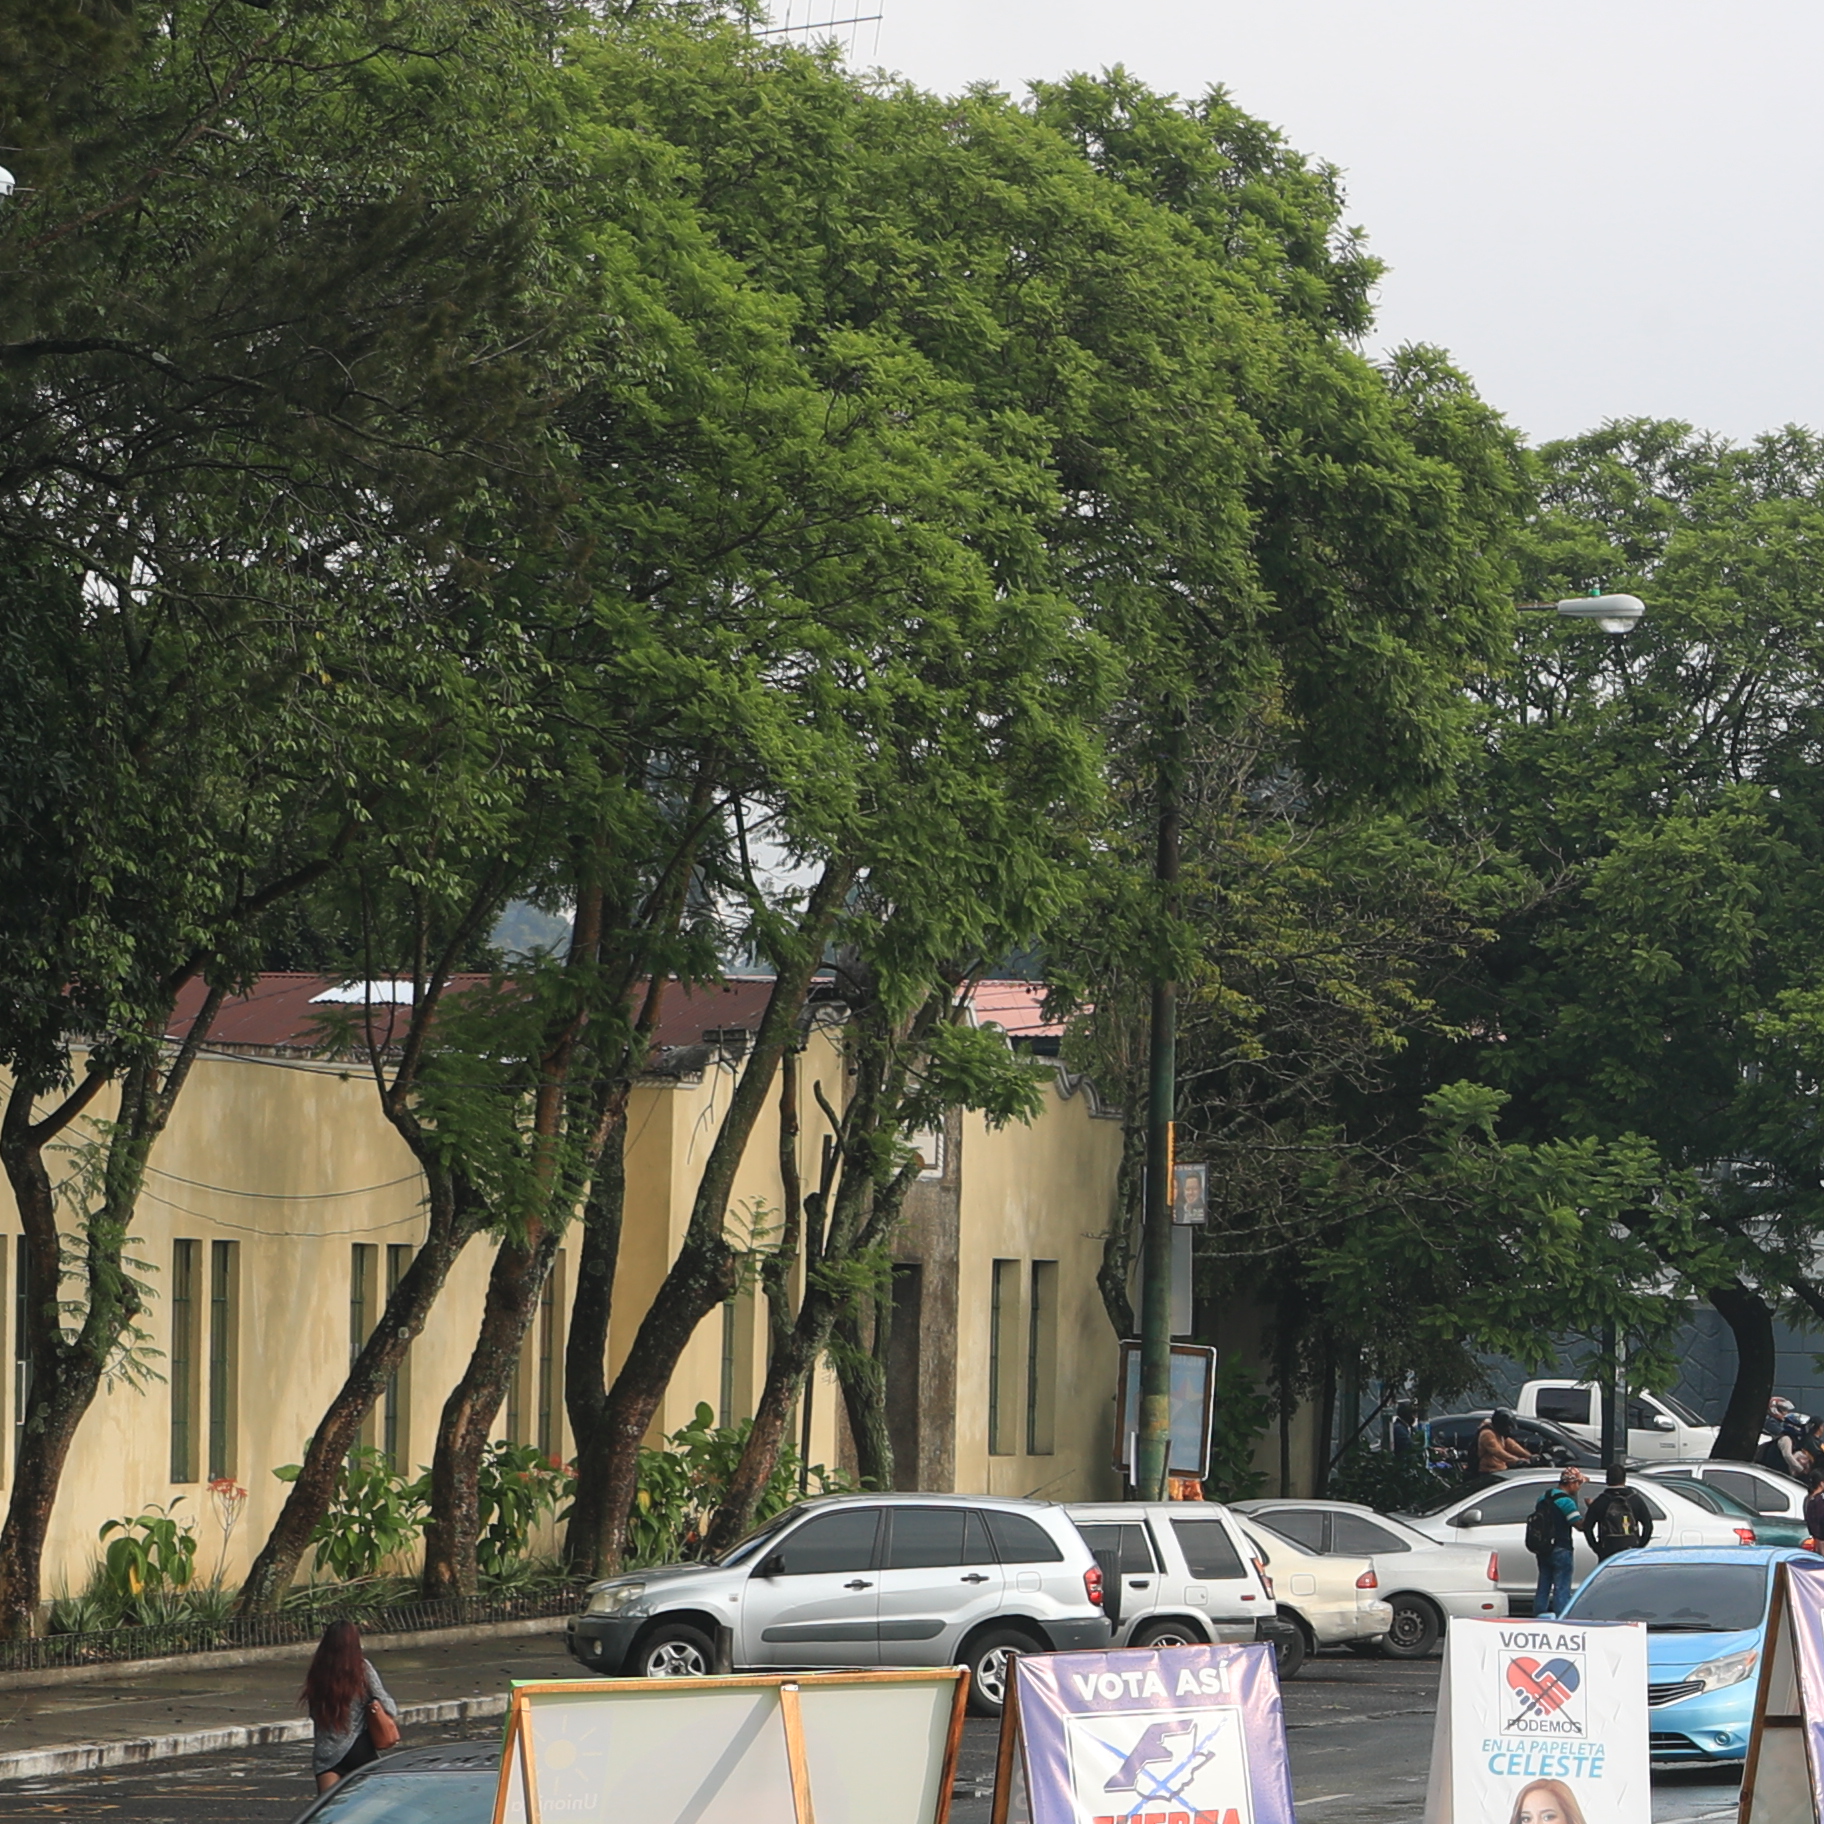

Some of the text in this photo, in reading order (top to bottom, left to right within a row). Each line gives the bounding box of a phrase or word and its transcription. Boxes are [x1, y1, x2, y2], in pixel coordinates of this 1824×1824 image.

[1499, 1631, 1587, 1652] VOTA ASÍ
[1072, 1660, 1231, 1701] VOTA ASÍ
[1506, 1717, 1583, 1734] PODEMOS
[1481, 1738, 1606, 1757] EN LA PAPELETA
[1487, 1753, 1606, 1779] CELESTE
